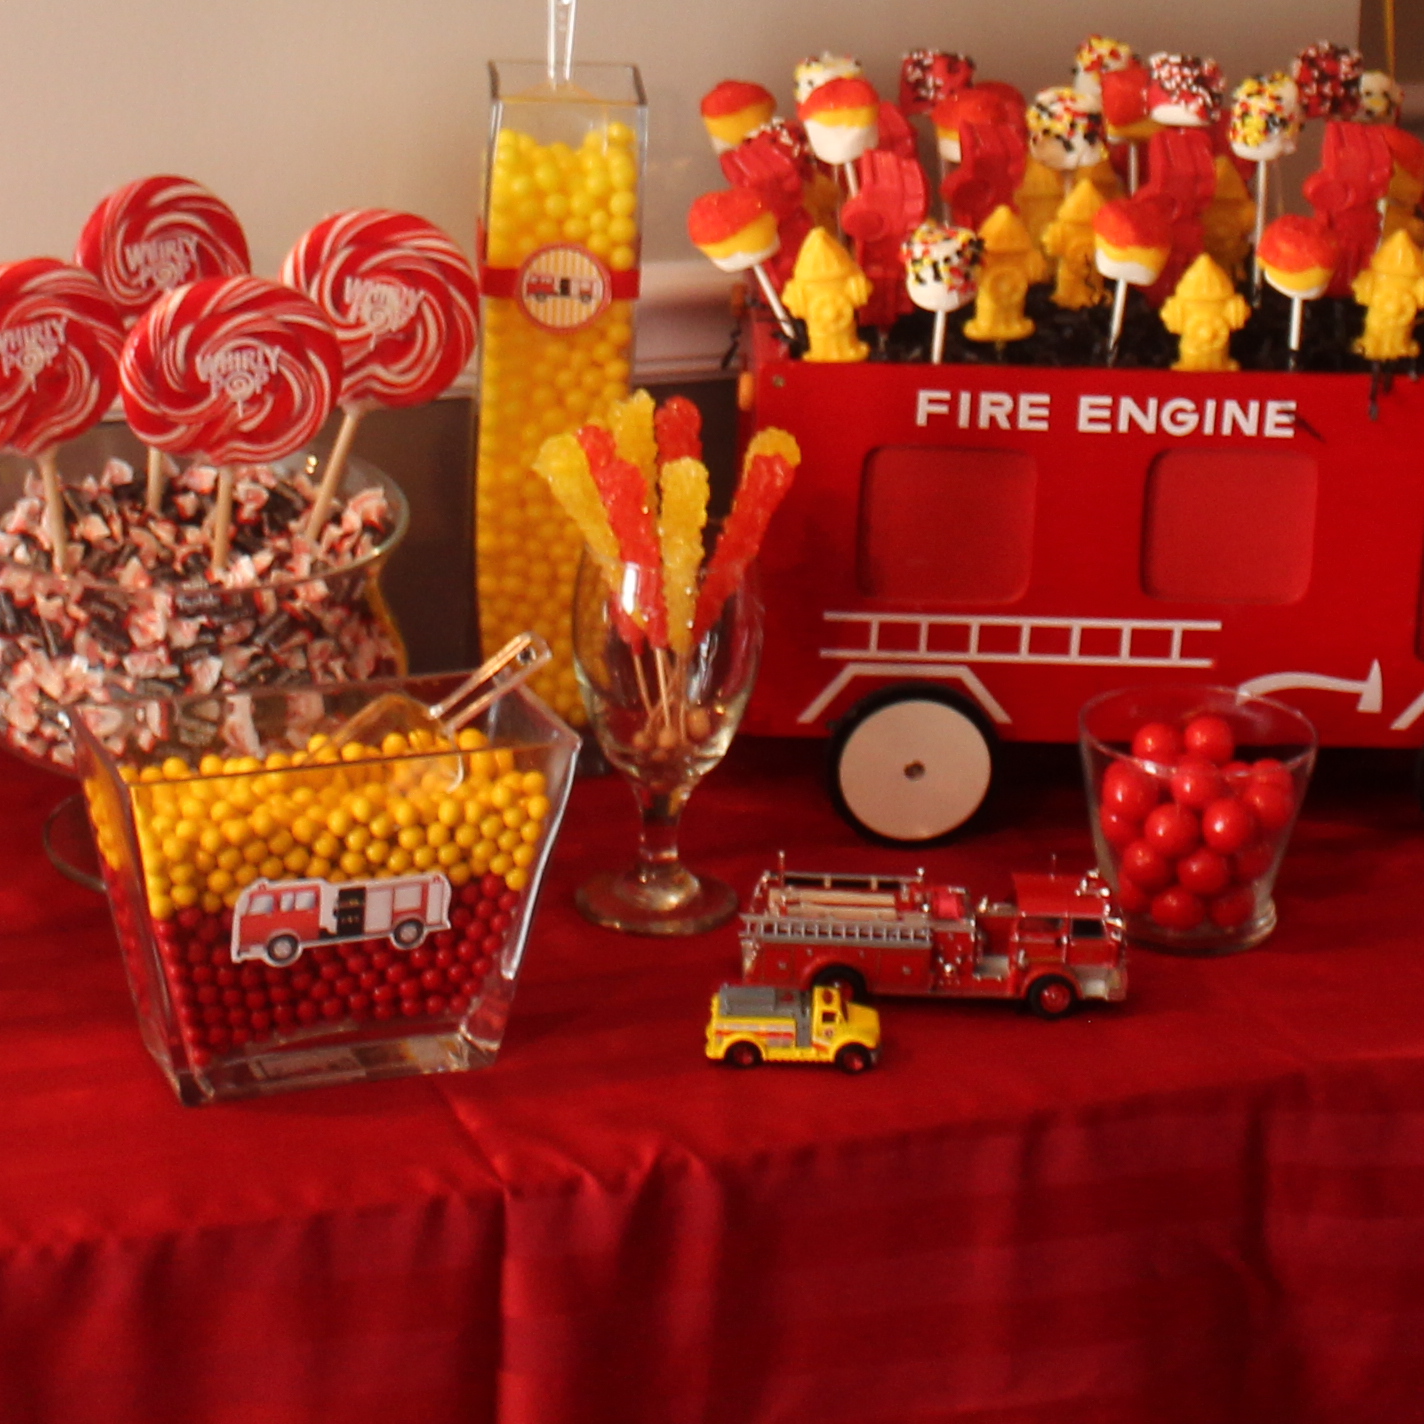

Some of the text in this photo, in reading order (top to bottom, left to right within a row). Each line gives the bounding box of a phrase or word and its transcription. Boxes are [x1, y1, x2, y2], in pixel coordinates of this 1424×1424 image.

[195, 345, 281, 383] WHIRLY
[916, 390, 1297, 438] FIRE ENGINE
